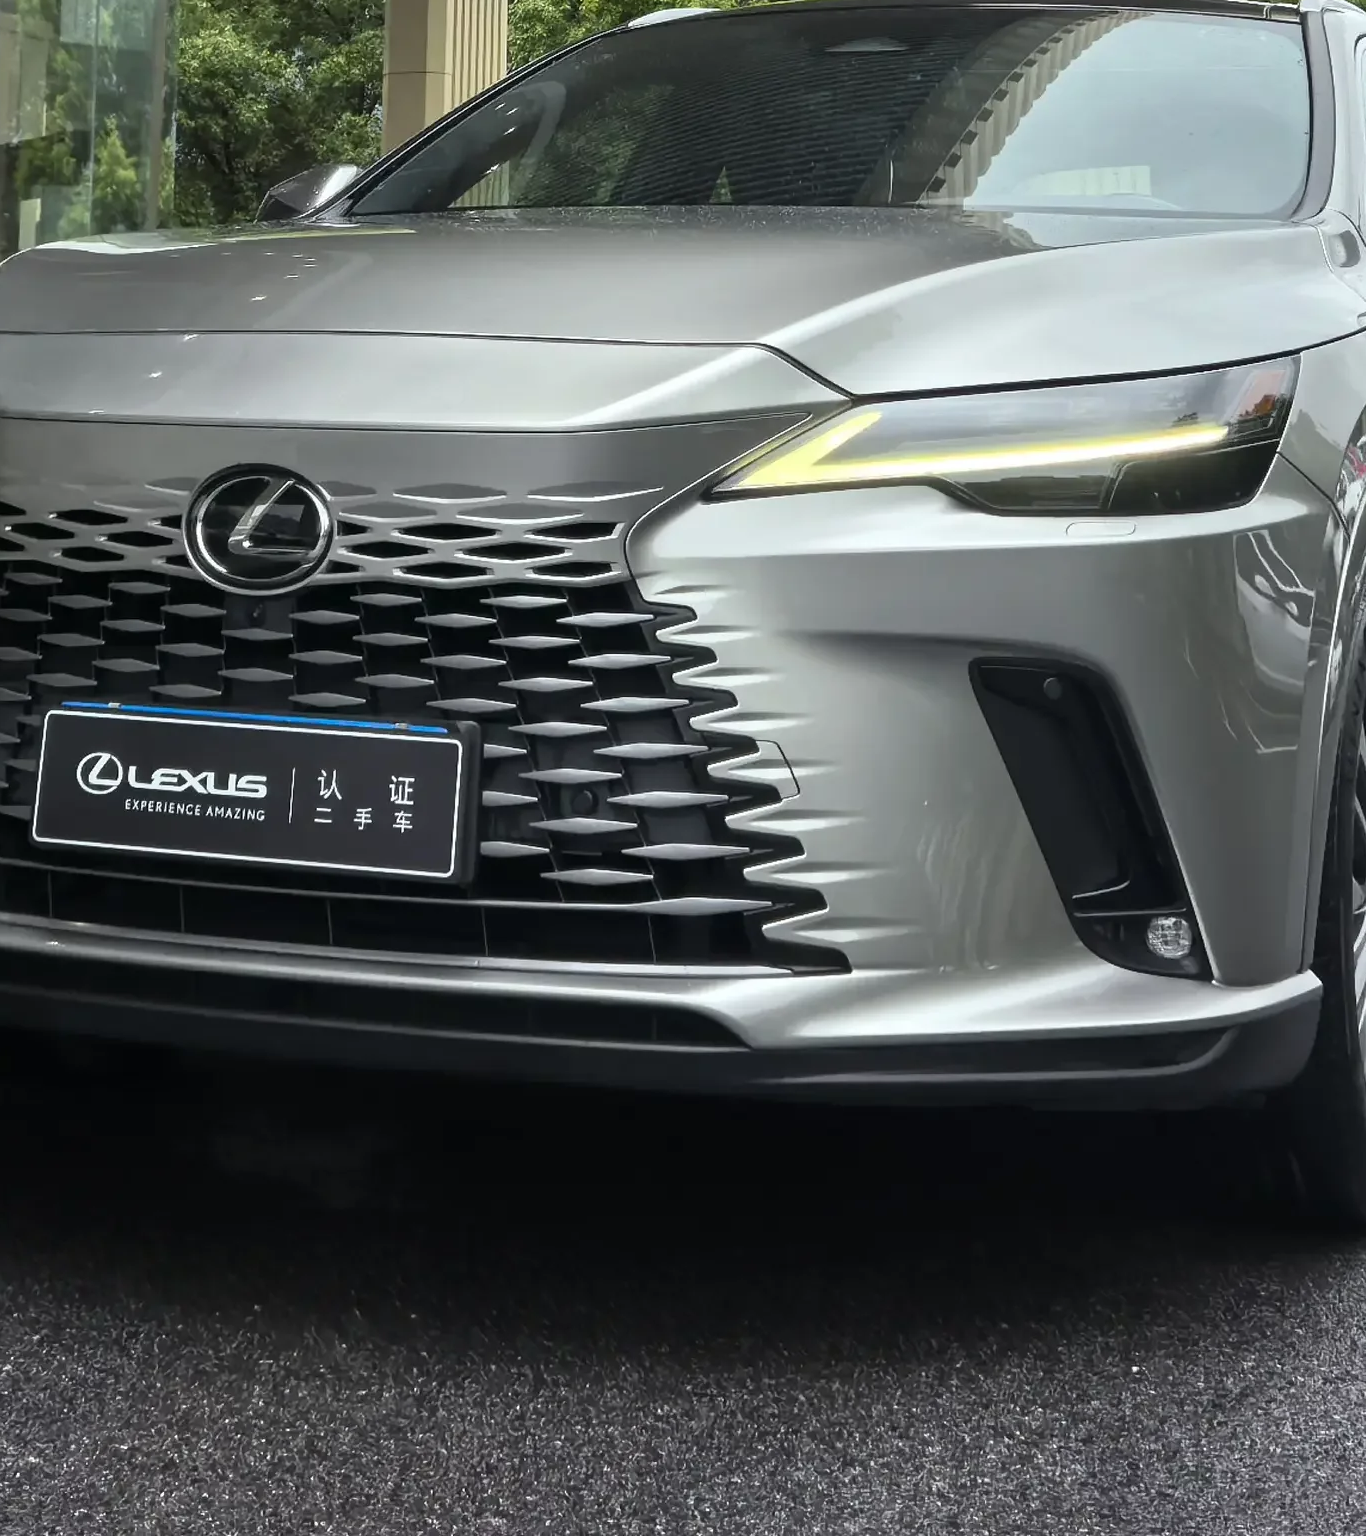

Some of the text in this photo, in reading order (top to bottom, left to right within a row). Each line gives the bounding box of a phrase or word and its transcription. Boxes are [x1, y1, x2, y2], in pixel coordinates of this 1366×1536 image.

[127, 765, 268, 799] LEXUS
[125, 798, 265, 821] EXPERIENCE AMAZING
